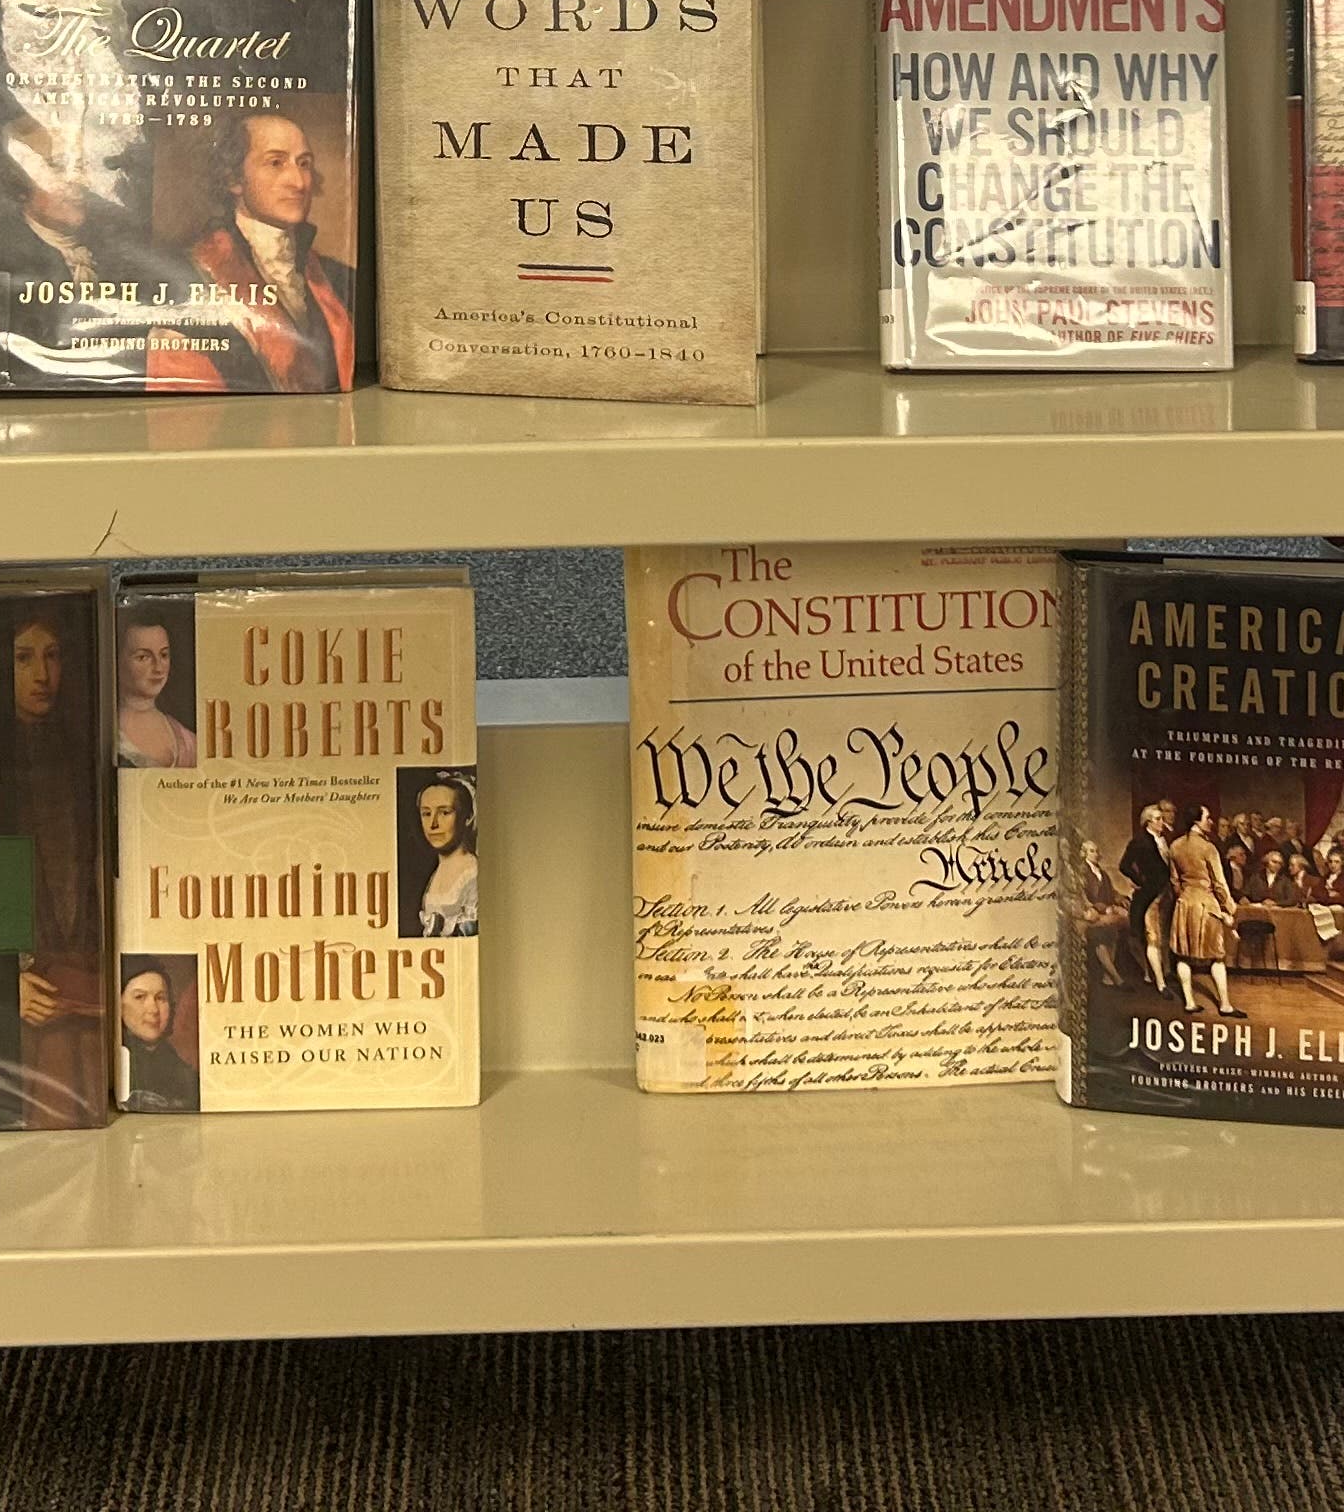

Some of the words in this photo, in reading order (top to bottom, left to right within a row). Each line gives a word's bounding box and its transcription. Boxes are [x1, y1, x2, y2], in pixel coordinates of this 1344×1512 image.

[124, 7, 292, 62] Quartet
[497, 66, 623, 88] THAT
[892, 52, 995, 101] HOW
[1008, 52, 1100, 101] AND
[1114, 52, 1218, 101] WHY
[432, 120, 692, 164] MADE
[510, 198, 615, 239] US
[892, 217, 1222, 269] CONSTITUTION
[434, 307, 535, 324] America's
[545, 311, 698, 329] Constitutional
[428, 338, 571, 359] Conversation,
[721, 547, 793, 583] The
[243, 625, 404, 687] COKIE
[724, 649, 755, 684] of
[764, 650, 811, 681] the
[819, 644, 925, 680] United
[933, 644, 1024, 675] States
[205, 697, 444, 759] ROBERTS
[157, 778, 195, 790] Author
[196, 777, 210, 790] of
[210, 777, 227, 788] the
[230, 776, 243, 788] #1
[246, 777, 270, 787] New
[273, 776, 295, 787] York
[298, 776, 327, 787] Times
[329, 776, 380, 786] Bestseller
[149, 862, 391, 929] Founding
[205, 940, 445, 1004] Mothers
[224, 1024, 269, 1039] THE
[279, 1022, 365, 1038] WOMEN
[375, 1021, 427, 1036] WHO
[1129, 1016, 1252, 1058] JOSEPH
[1264, 1027, 1284, 1060] J.
